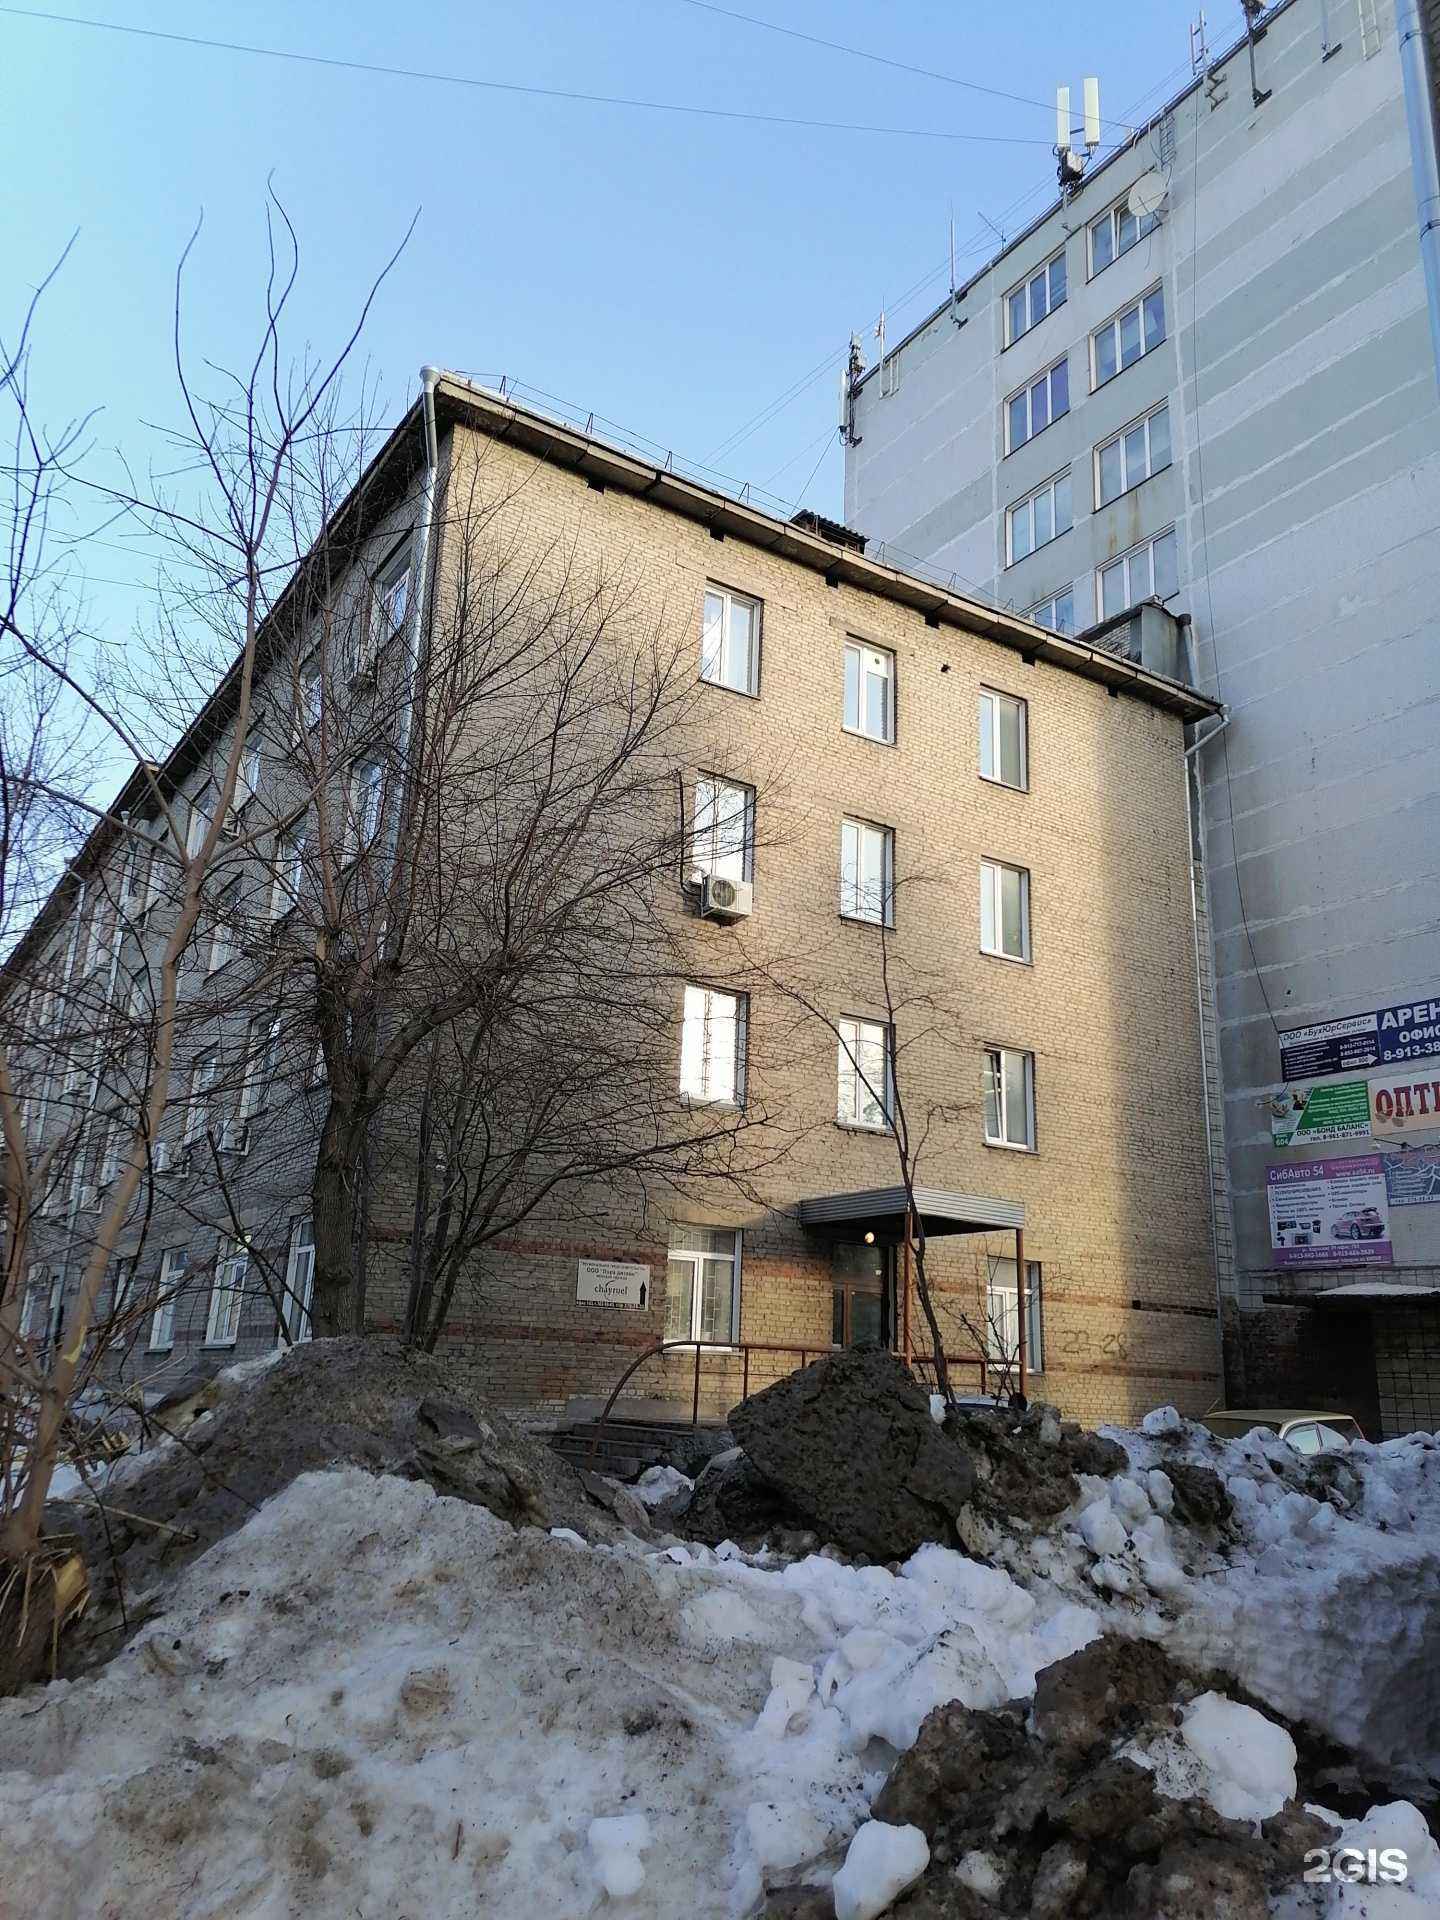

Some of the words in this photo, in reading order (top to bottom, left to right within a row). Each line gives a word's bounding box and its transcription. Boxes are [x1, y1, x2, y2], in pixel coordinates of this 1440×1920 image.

[1283, 1031, 1302, 1041] ООО
[1296, 1129, 1311, 1137] ООО
[1270, 1167, 1311, 1181] СибАвто
[1312, 1165, 1324, 1177] 54
